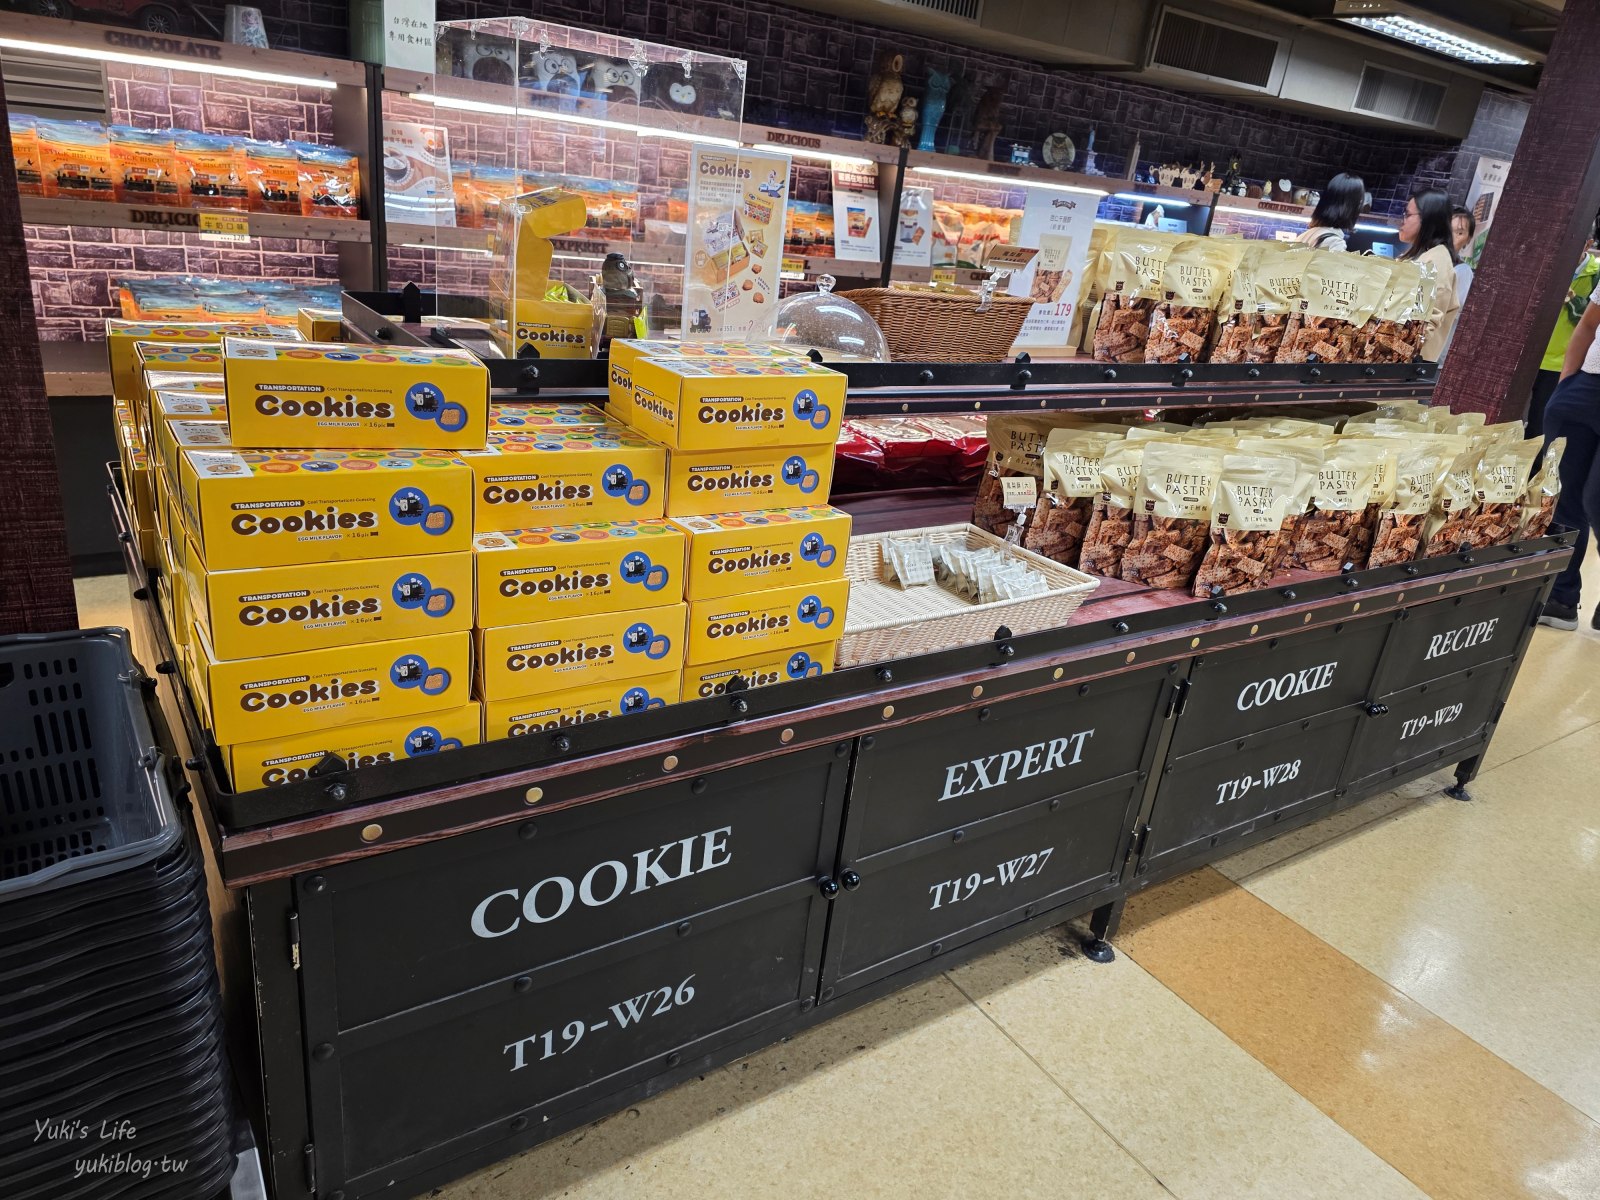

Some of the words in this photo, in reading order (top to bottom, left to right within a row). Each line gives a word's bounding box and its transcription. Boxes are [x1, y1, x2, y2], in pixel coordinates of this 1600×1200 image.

[393, 16, 428, 29] 台灣在地
[104, 30, 222, 60] CHOCOLATE
[767, 131, 821, 149] DELICIOUS
[700, 161, 751, 179] Cookies
[1180, 265, 1212, 279] BUTTER
[1180, 276, 1213, 287] PASTRY
[1054, 303, 1072, 317] 179
[516, 328, 585, 344] Cookies
[258, 384, 322, 392] TRANSPORTATION
[255, 394, 394, 419] Cookies
[634, 391, 674, 421] Cookies
[698, 402, 785, 424] Cookies
[1063, 454, 1101, 467] BUTTER
[1064, 465, 1101, 476] PASTRY
[687, 469, 775, 492] Cookies
[1166, 473, 1212, 486] BUTTER
[1318, 470, 1357, 480] BUTTER
[1320, 480, 1357, 491] PASTRY
[483, 480, 592, 505] Cookies
[1165, 484, 1211, 497] PASTRY
[1237, 485, 1273, 498] BUTTER
[235, 501, 302, 510] TRANSPORTATION
[1237, 496, 1273, 508] PASTRY
[231, 506, 377, 536] Cookies
[503, 566, 554, 576] TRANSPORTATION
[708, 549, 793, 574] Cookies
[499, 570, 611, 597] Cookies
[242, 590, 307, 602] TRANSPORTATION
[239, 595, 381, 627] Cookies
[706, 613, 789, 639] Cookies
[1424, 618, 1499, 661] RECIPE
[506, 643, 614, 672] Cookies
[243, 675, 307, 690] TRANSPORTATION
[698, 671, 780, 698] Cokies
[1236, 662, 1337, 711] COOKIE
[240, 678, 380, 712] Cookies
[1400, 703, 1463, 740] T19-W29
[265, 751, 325, 766] TRANSPORTATION
[938, 728, 1095, 802] EXPERT
[1216, 759, 1301, 805] T19-W28
[470, 825, 732, 938] COOKIE
[929, 847, 1054, 910] T19-W27
[503, 973, 696, 1072] T19-W26
